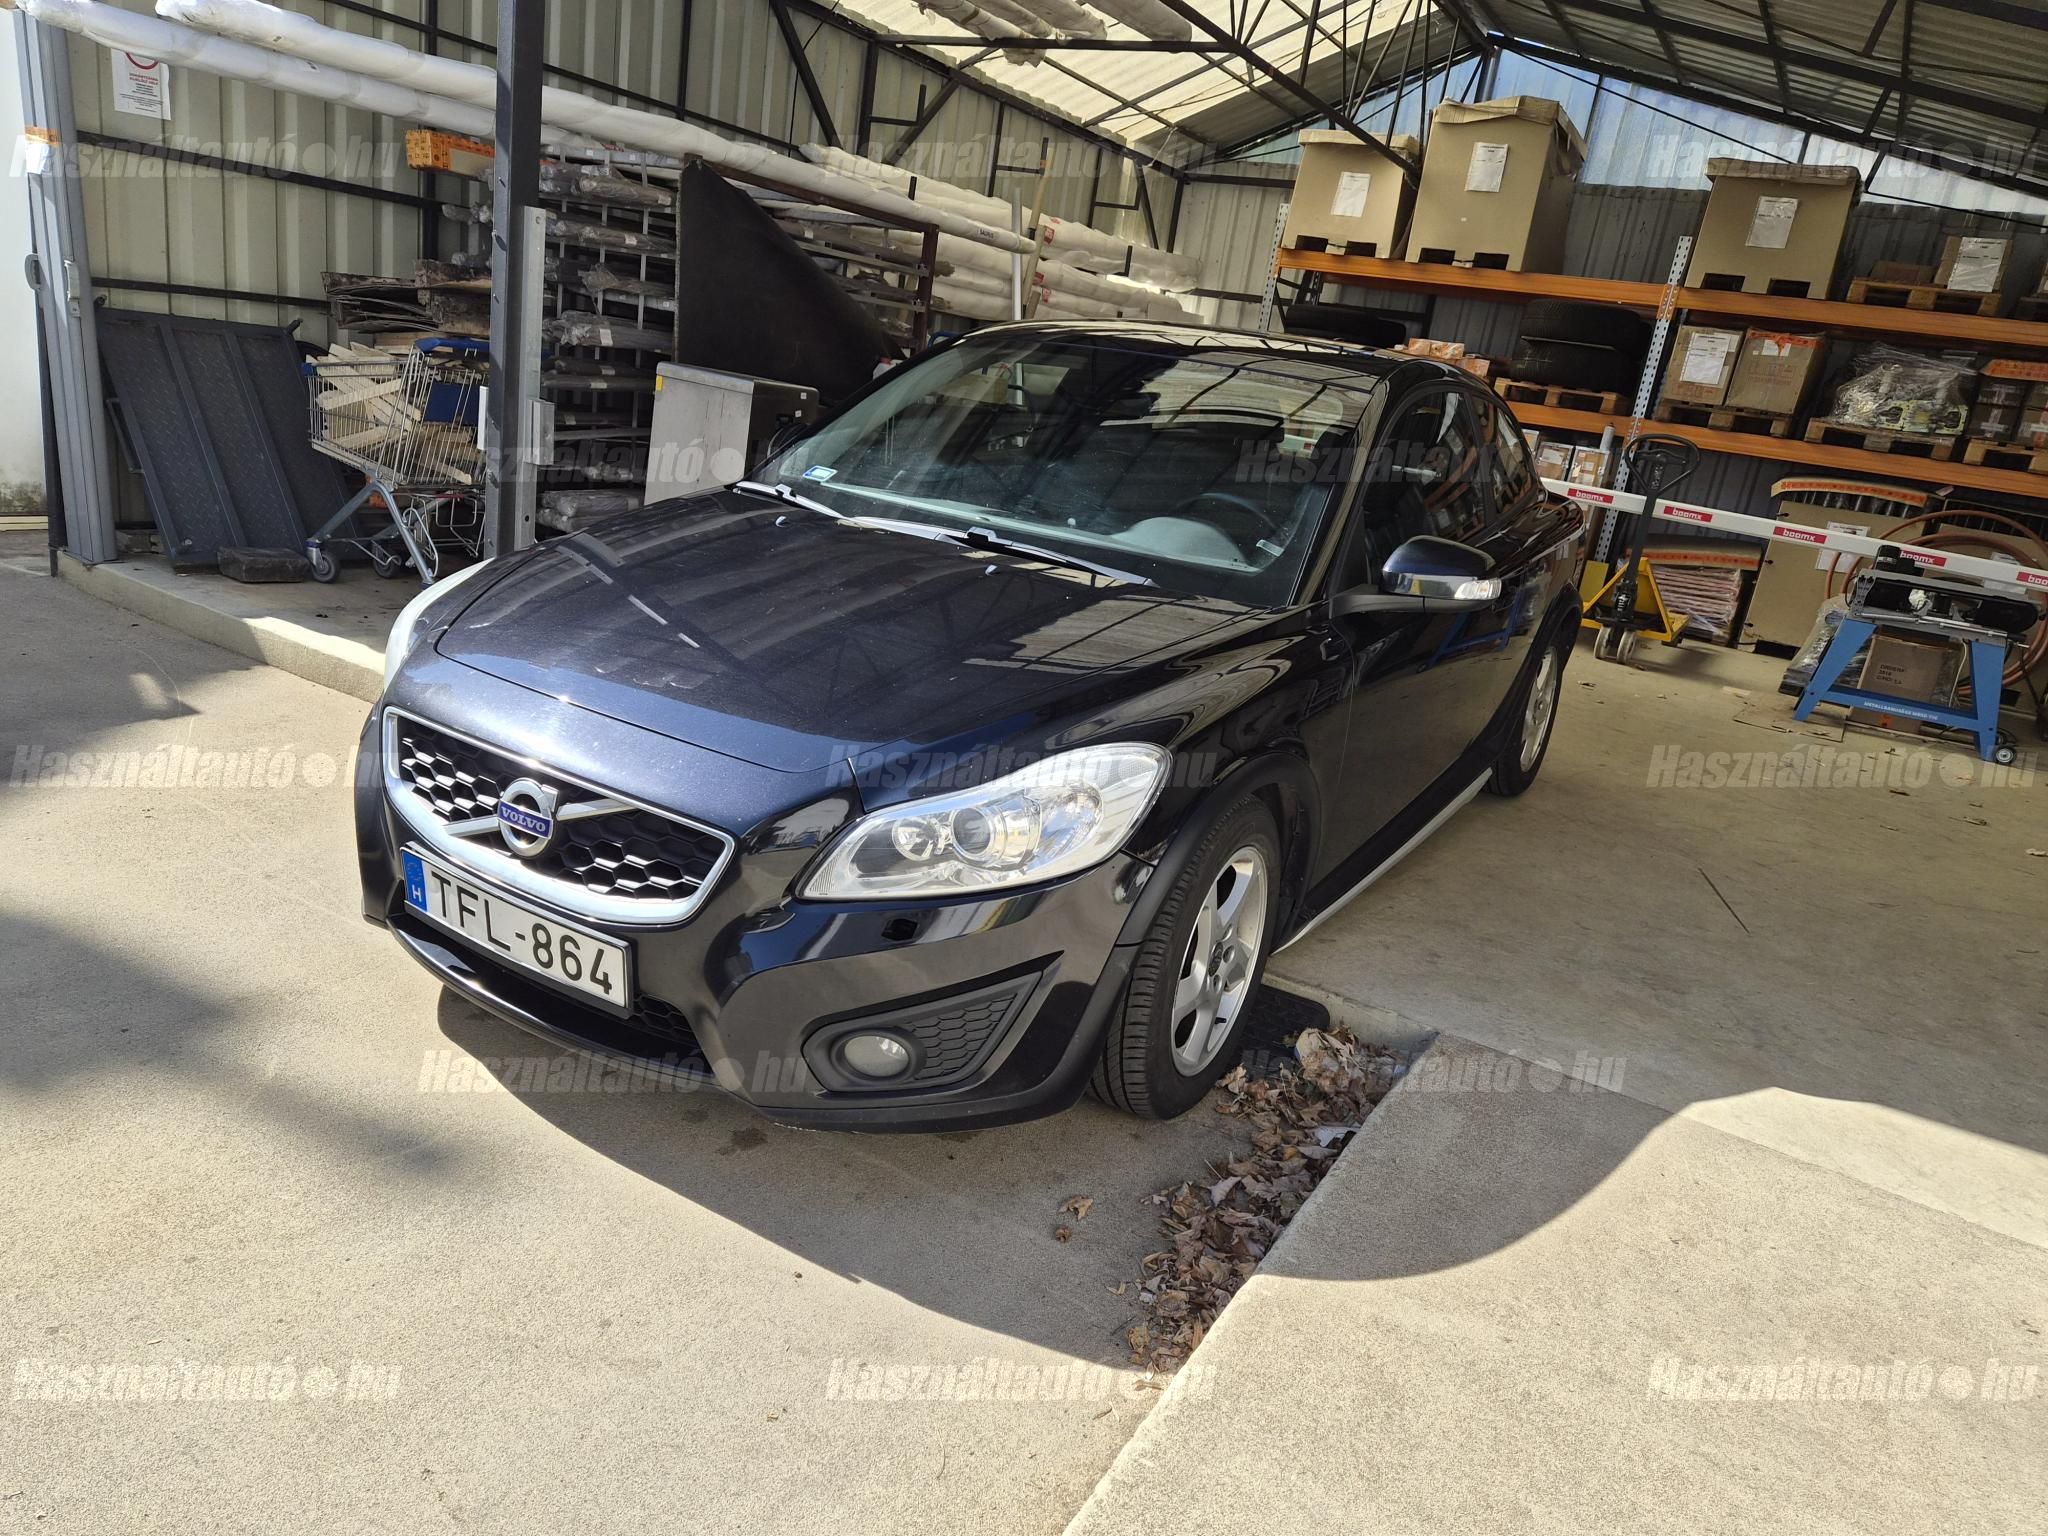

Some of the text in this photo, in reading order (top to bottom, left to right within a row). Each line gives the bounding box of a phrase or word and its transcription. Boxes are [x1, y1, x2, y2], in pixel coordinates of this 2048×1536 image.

[500, 806, 546, 832] VOLVO
[411, 884, 423, 903] H
[431, 870, 613, 996] TFL-864
